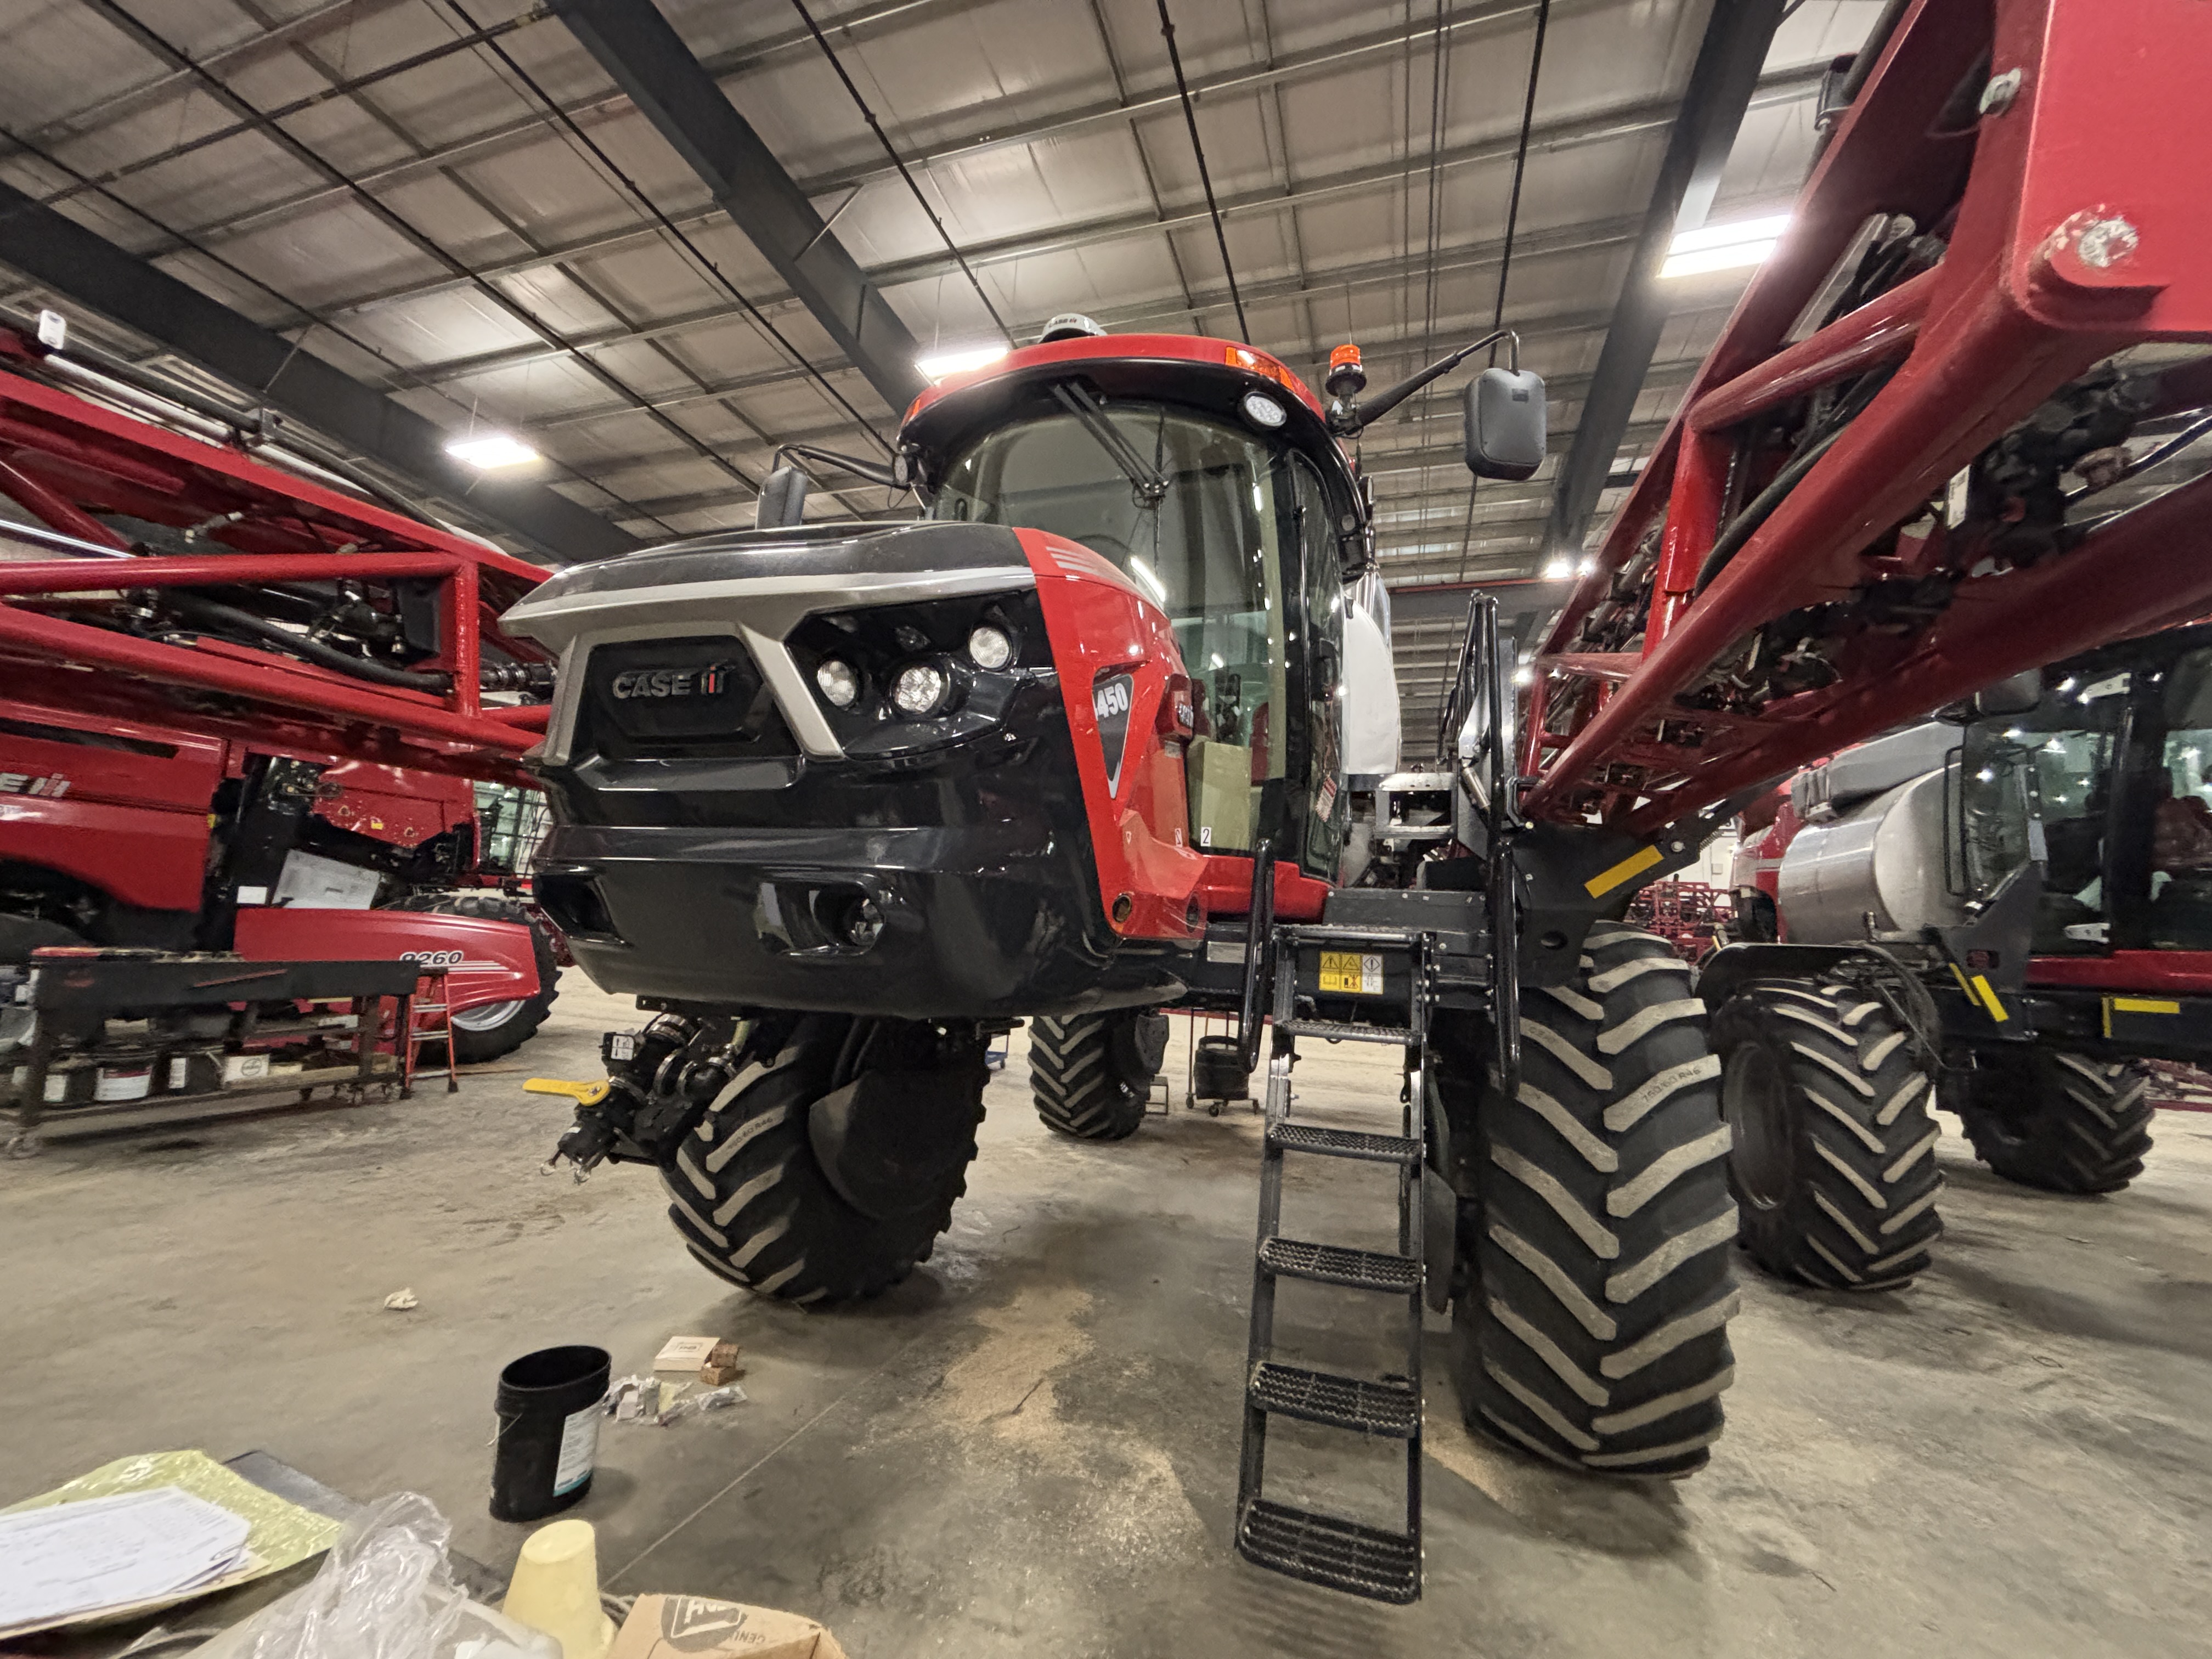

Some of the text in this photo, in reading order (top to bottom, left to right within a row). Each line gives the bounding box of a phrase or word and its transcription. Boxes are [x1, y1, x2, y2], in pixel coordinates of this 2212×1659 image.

[613, 670, 691, 699] CASE
[1097, 682, 1128, 718] 450
[1202, 828, 1210, 844] 2
